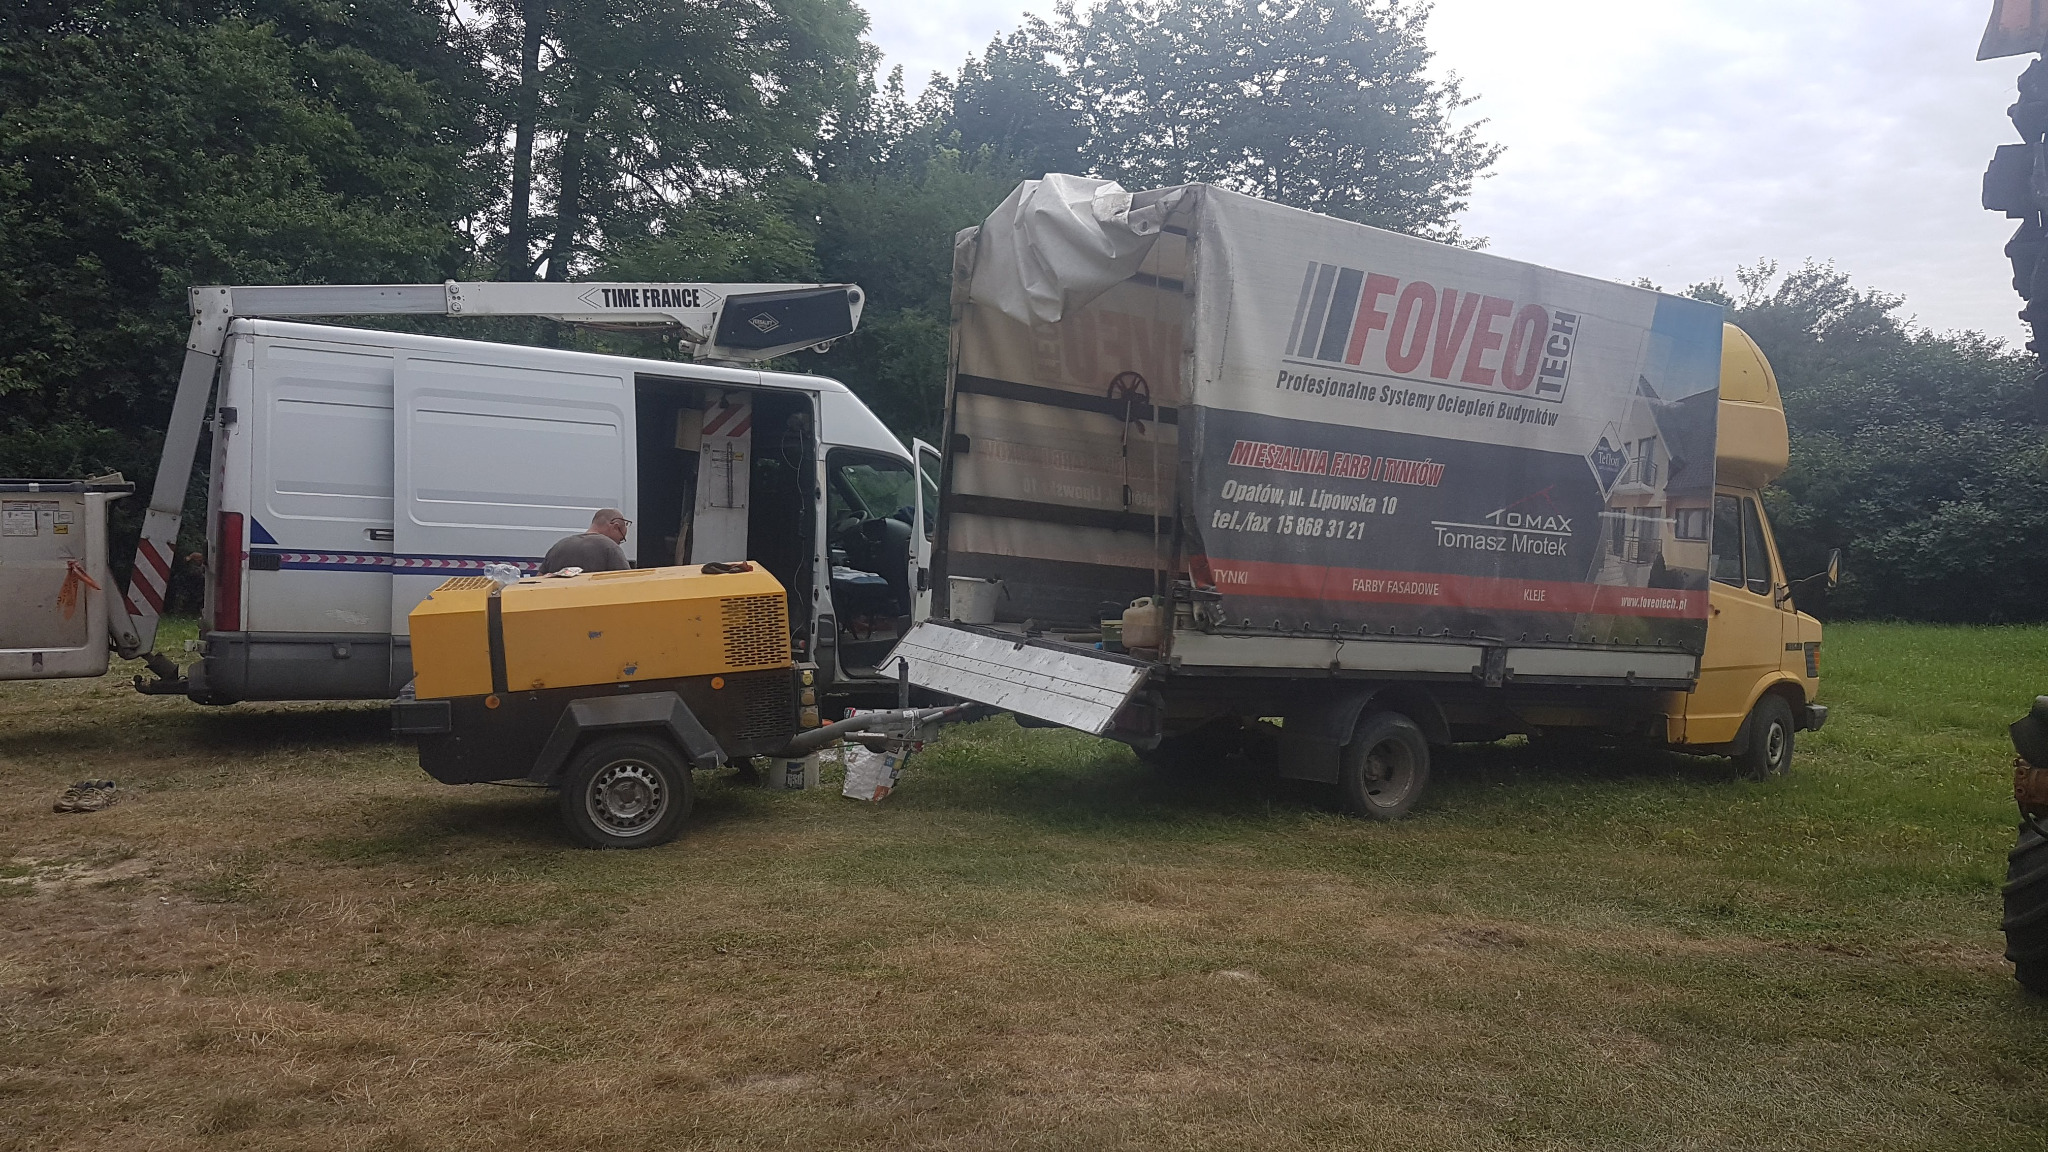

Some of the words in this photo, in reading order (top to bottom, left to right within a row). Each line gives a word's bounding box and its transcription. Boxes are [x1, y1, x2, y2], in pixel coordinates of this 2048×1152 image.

[602, 288, 640, 308] TIME
[643, 288, 701, 308] FRANCE
[1344, 272, 1549, 391] FOVEO
[1535, 310, 1578, 395] TECH
[1276, 370, 1376, 402] Profesjonalne
[1379, 385, 1435, 411] Systemy
[1437, 394, 1495, 419] Ociepleń
[1496, 402, 1560, 427] Budynków
[1228, 440, 1329, 475] MIESZALNIA
[1329, 453, 1372, 480] FARB
[1371, 456, 1384, 481] I
[1383, 458, 1445, 487] TYNKÓW
[1221, 480, 1284, 507] Opatów,
[1289, 488, 1304, 506] ul.
[1309, 488, 1376, 514] Lipowska
[1381, 496, 1398, 515] 10
[1211, 509, 1272, 533] tel./fax
[1276, 515, 1294, 534] 15
[1296, 517, 1323, 537] 868
[1325, 519, 1344, 539] 31
[1346, 521, 1365, 540] 21
[1485, 508, 1573, 532] TOMAX
[1434, 527, 1506, 551] Tomasz
[1512, 533, 1567, 556] Mrotek
[1214, 569, 1248, 584] TYNKI
[1352, 578, 1385, 593] FARBY
[1387, 580, 1439, 596] FASADOWE
[1523, 588, 1546, 602] KLEJE
[1621, 595, 1688, 610] www.foveotech.pl
